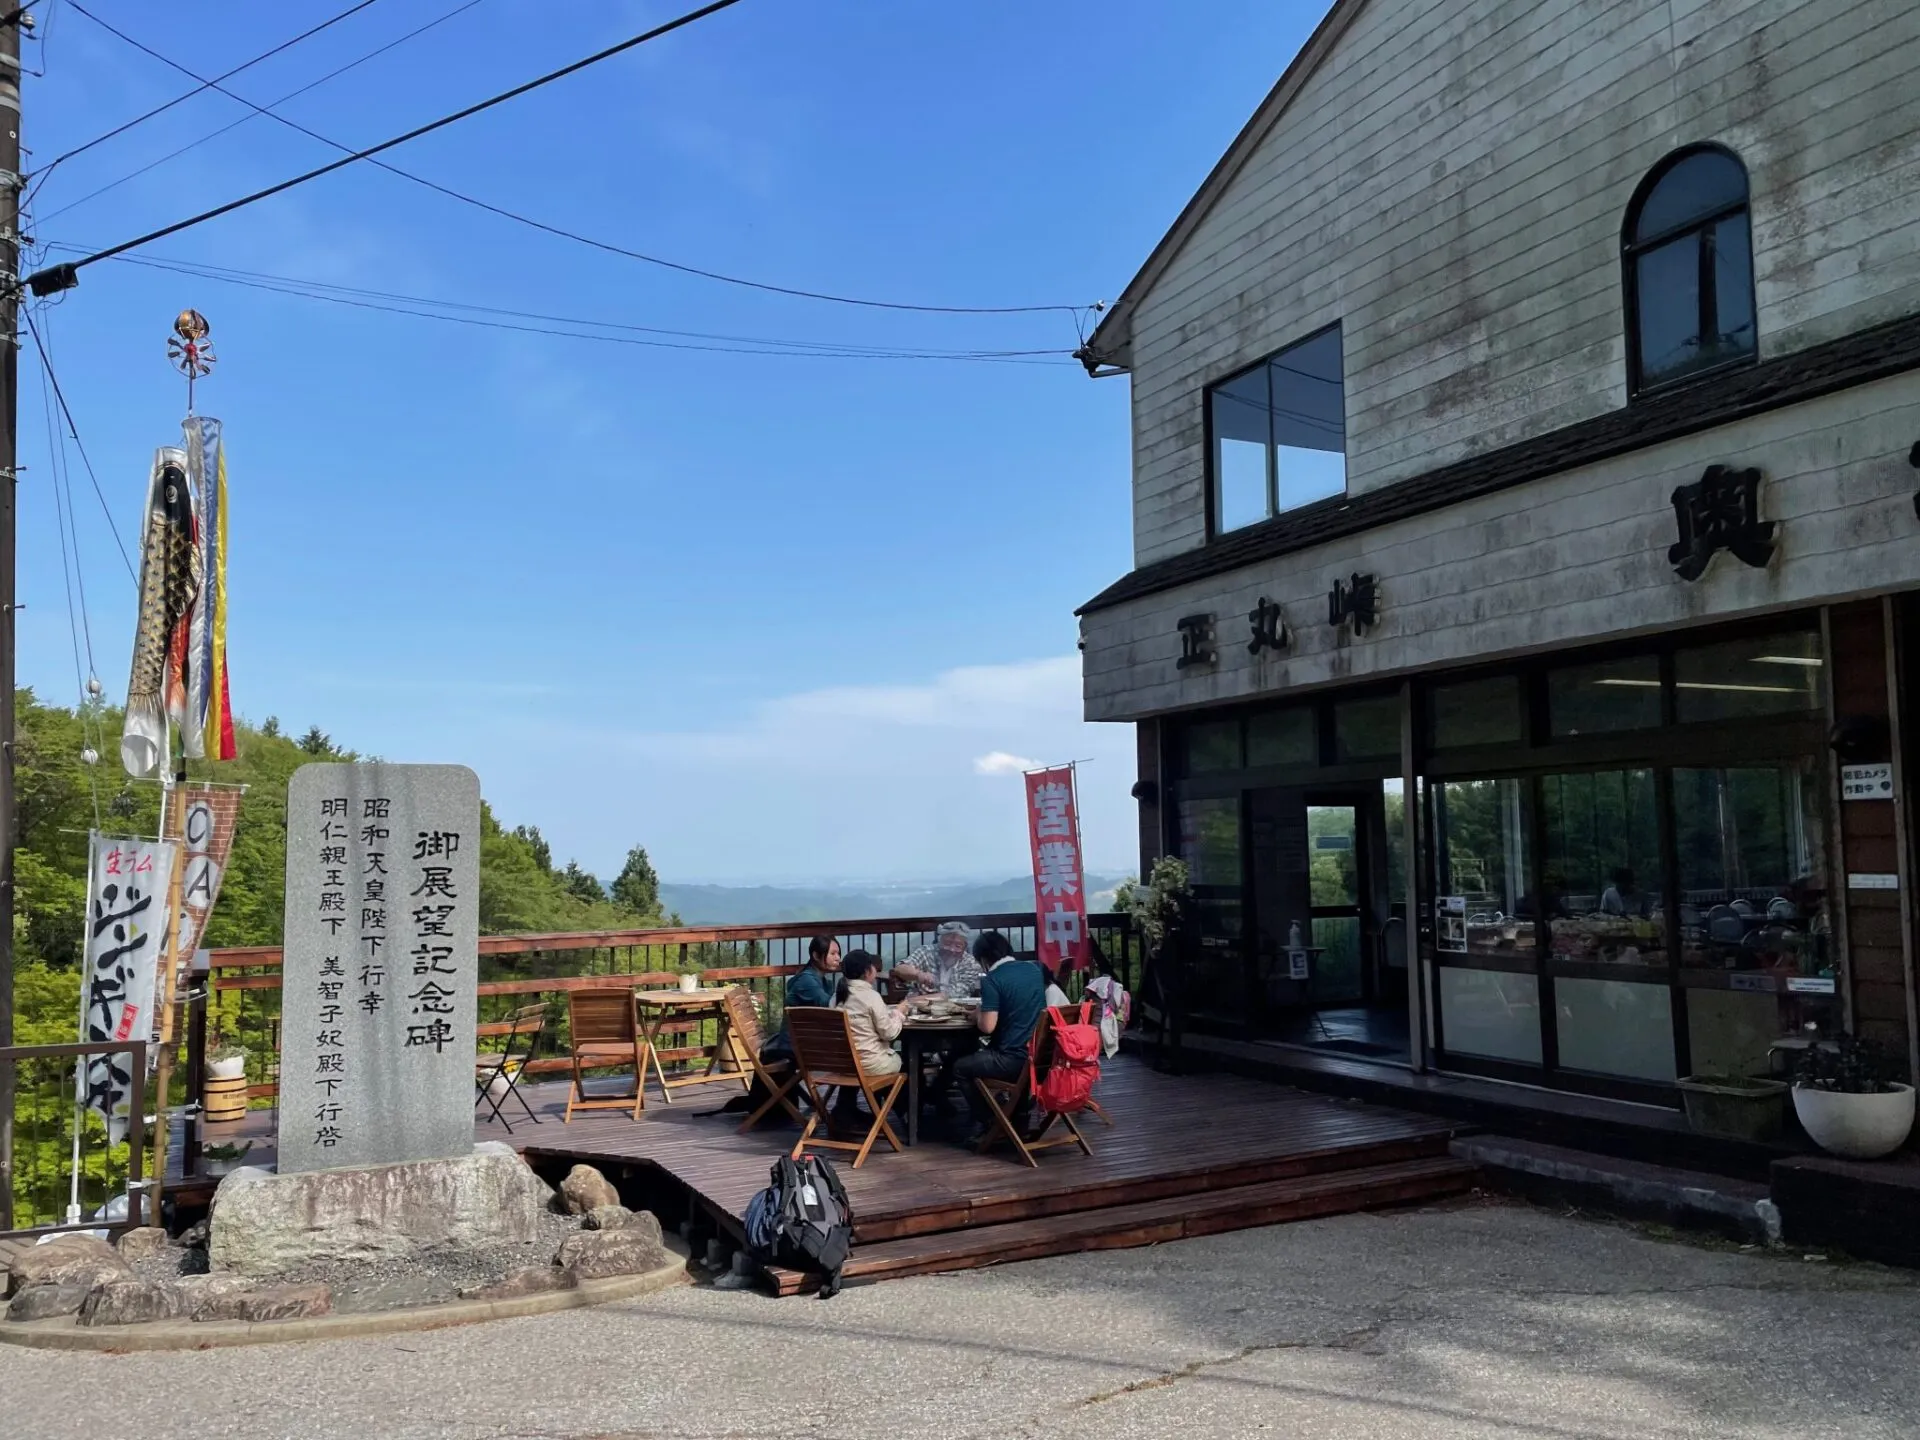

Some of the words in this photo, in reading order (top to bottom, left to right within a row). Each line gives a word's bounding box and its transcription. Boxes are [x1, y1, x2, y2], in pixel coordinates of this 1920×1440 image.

[1176, 573, 1379, 670] 正丸峠
[106, 845, 152, 875] 生ラム
[319, 798, 348, 936] 明仁親王殿下
[358, 798, 391, 1015] 昭和天皇陛下行幸
[404, 831, 460, 1054] 御展望記念碑
[1034, 782, 1080, 957] 営業中
[314, 956, 345, 1148] 美智子妃殿下行啓
